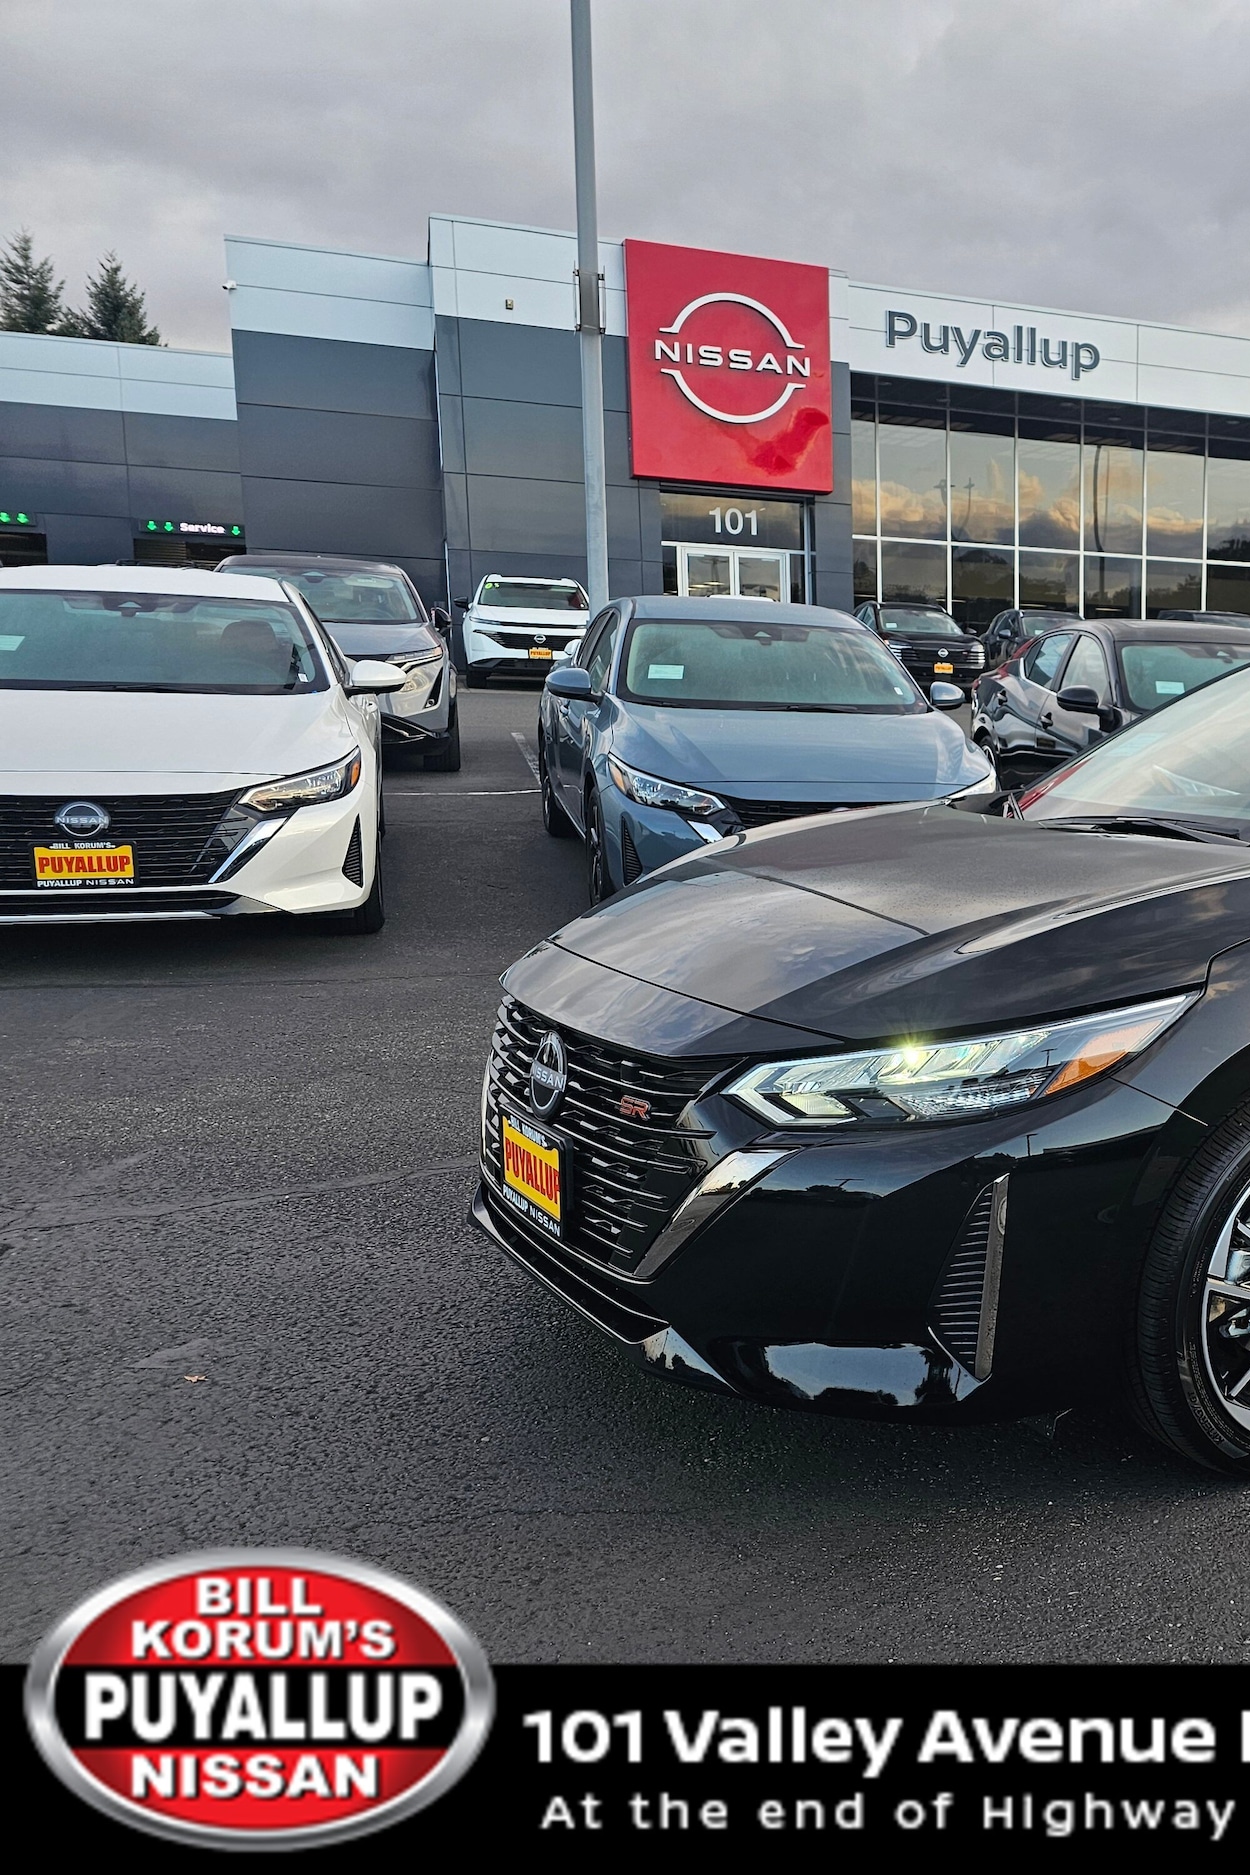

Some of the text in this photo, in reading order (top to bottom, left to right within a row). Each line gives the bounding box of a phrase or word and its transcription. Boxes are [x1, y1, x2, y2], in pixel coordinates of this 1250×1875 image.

[654, 339, 811, 378] NISSAN
[886, 310, 1100, 379] Puyallup
[180, 522, 225, 534] Service
[708, 507, 758, 536] 101
[38, 855, 131, 874] PUYALLUP
[37, 880, 82, 888] PUYALLUP
[620, 1095, 651, 1120] SR
[504, 1136, 560, 1205] PUYALLUP
[502, 1183, 560, 1237] PUYALLUP NISSAN
